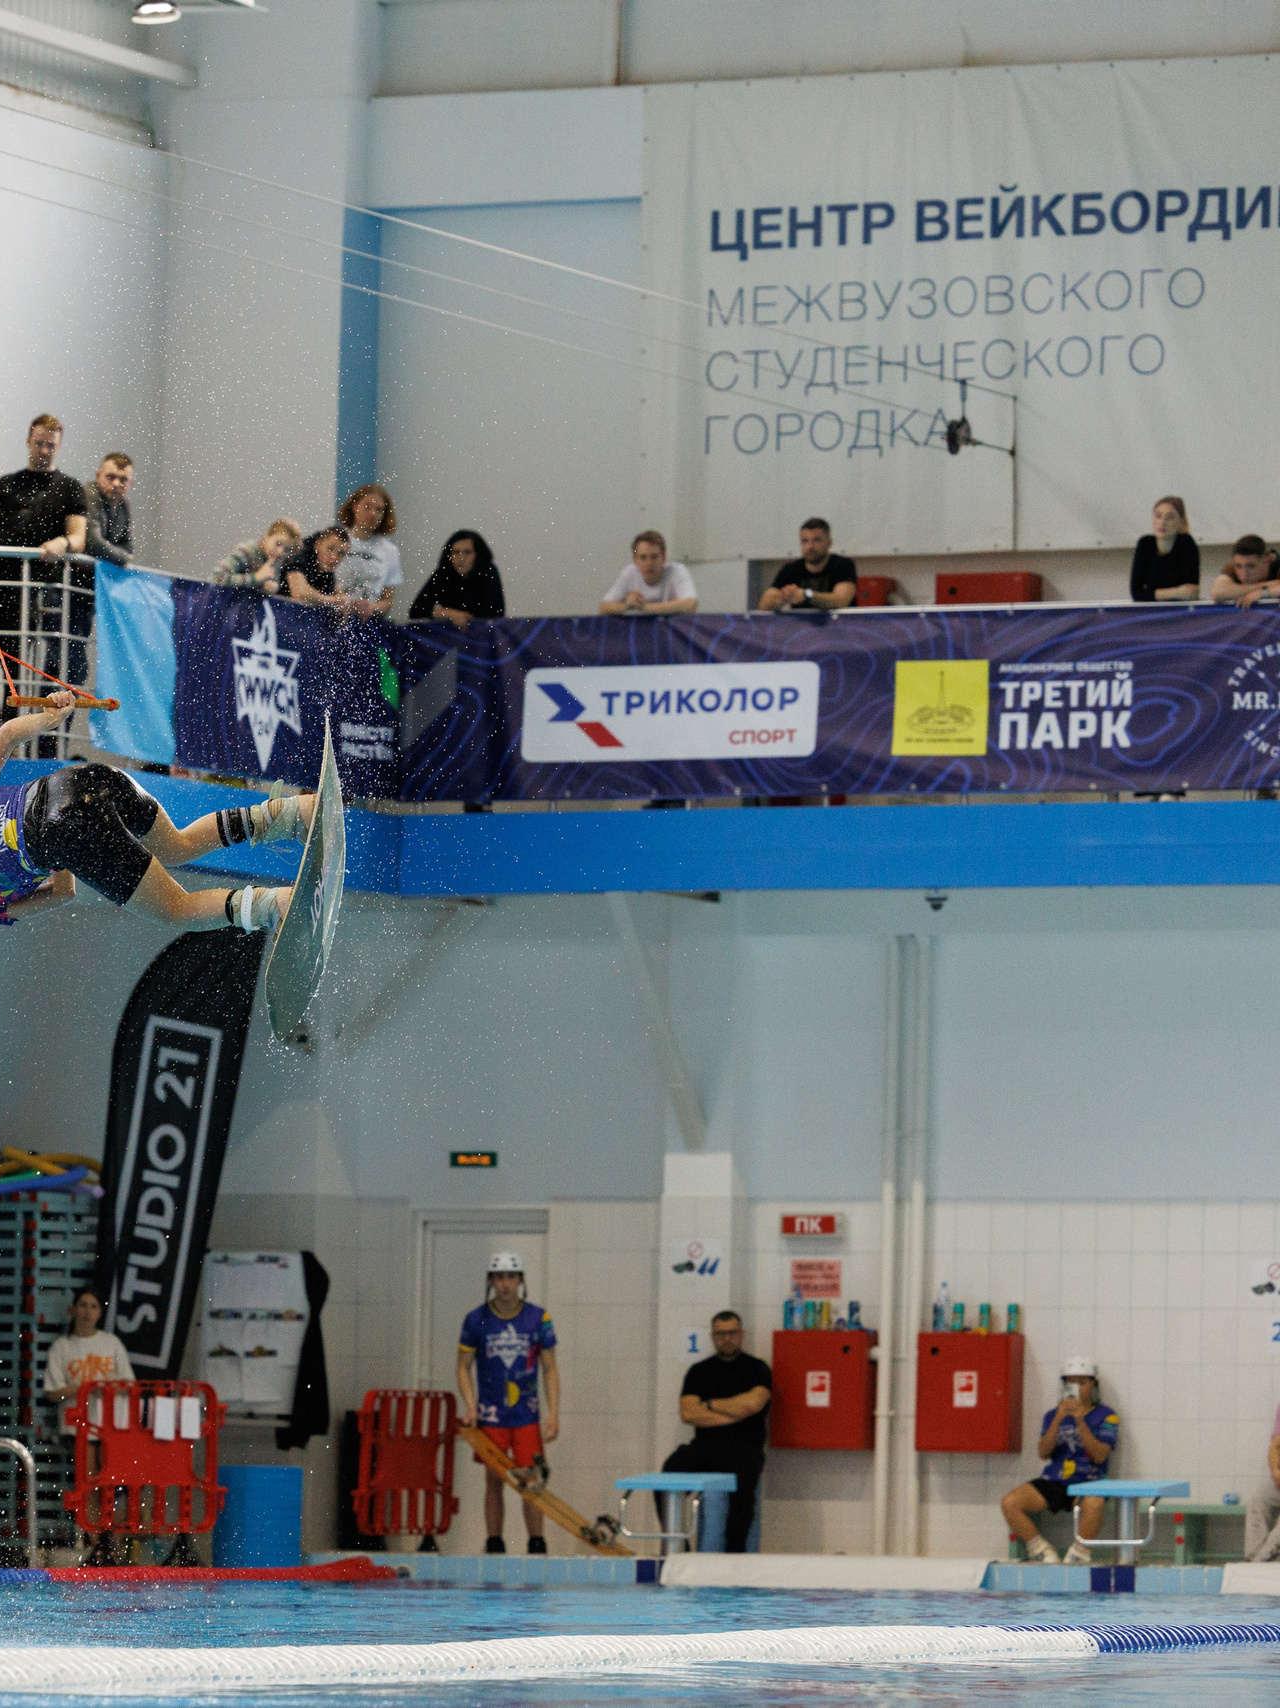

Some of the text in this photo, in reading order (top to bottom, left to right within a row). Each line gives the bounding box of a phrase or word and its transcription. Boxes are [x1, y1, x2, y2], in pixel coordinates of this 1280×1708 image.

[710, 202, 895, 261] ЦЕНТР
[707, 267, 1206, 328] МЕЖВУЗОВСКОГО
[705, 333, 1166, 395] СТУДЕНЧЕСКОГО
[704, 408, 953, 458] ГОРОДКА
[1227, 642, 1280, 687] TRAVE
[601, 686, 800, 717] ТРИКОЛОР
[999, 672, 1133, 709] ТРЕТИЙ
[1232, 691, 1280, 710] MR.
[729, 728, 797, 746] СПОРТ
[998, 711, 1132, 750] ПАРК
[117, 1046, 201, 1335] STUDIO 21
[794, 1215, 823, 1234] ПК
[687, 1334, 701, 1354] 1
